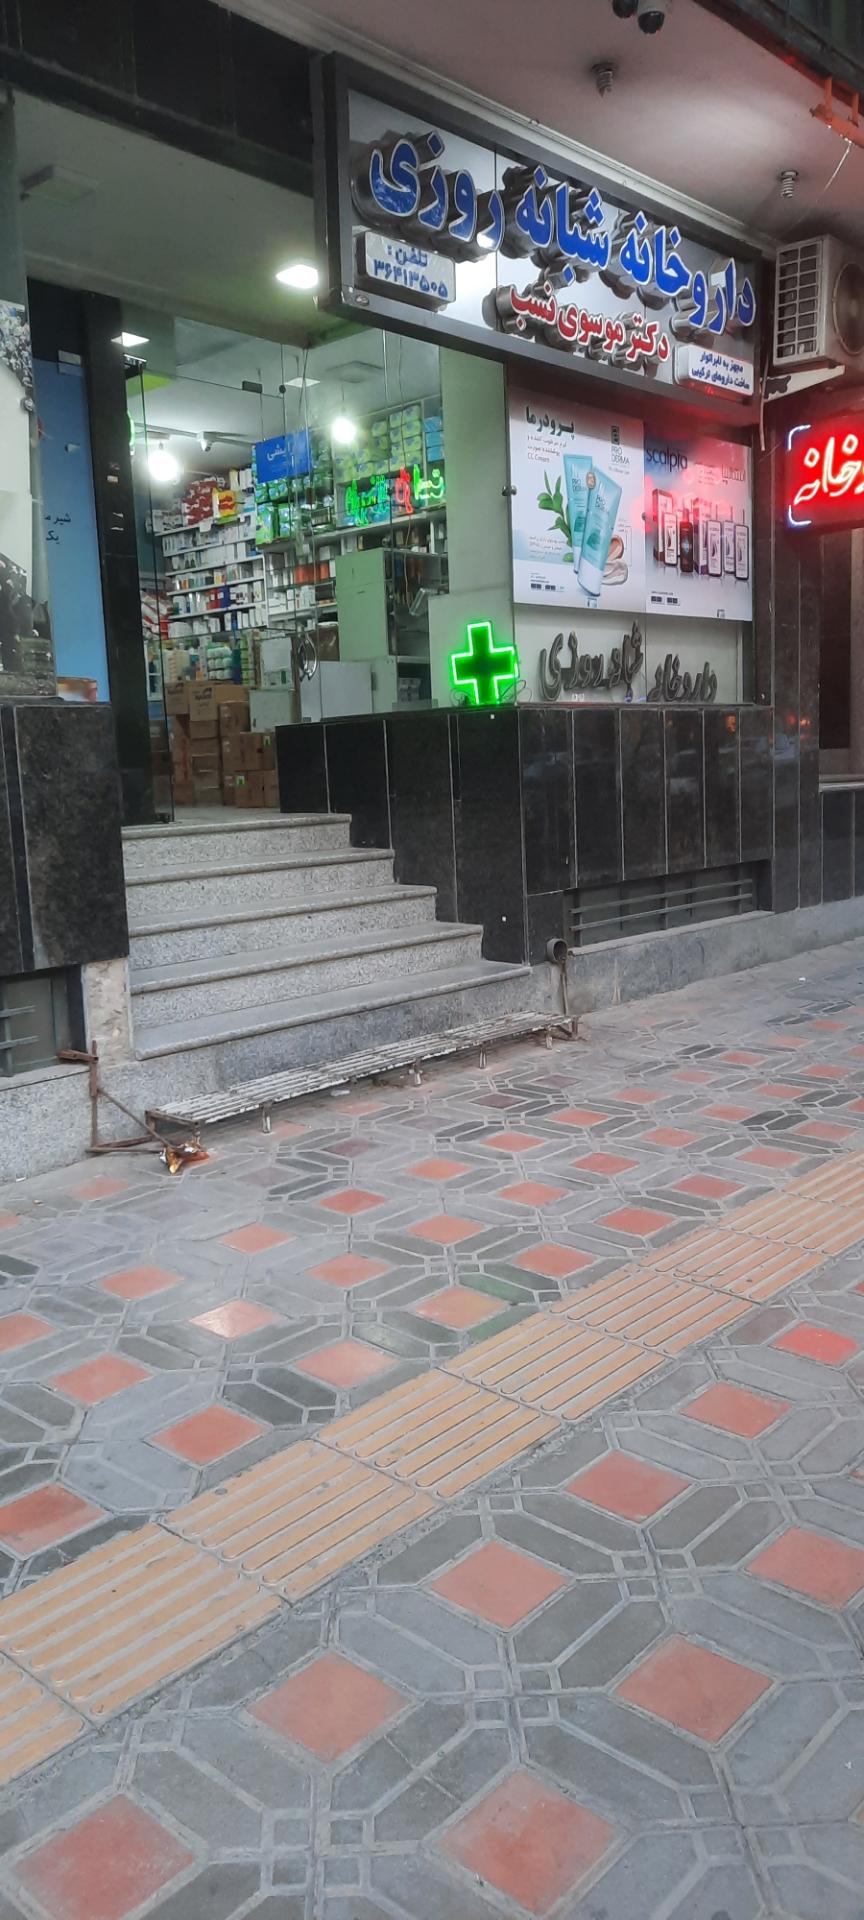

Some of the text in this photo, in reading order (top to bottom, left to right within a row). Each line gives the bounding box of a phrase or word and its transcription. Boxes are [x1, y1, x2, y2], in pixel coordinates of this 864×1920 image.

[369, 129, 757, 335] داروخانه شبانه روزی
[373, 258, 448, 298] ۳۶۴۱۳۵۰۵
[509, 281, 670, 361] دکتر موسوی نسب
[692, 366, 749, 389] ساخت داروهای ترکیبی
[700, 351, 743, 373] مجهز به لابراتوار
[525, 405, 575, 441] پرودرما
